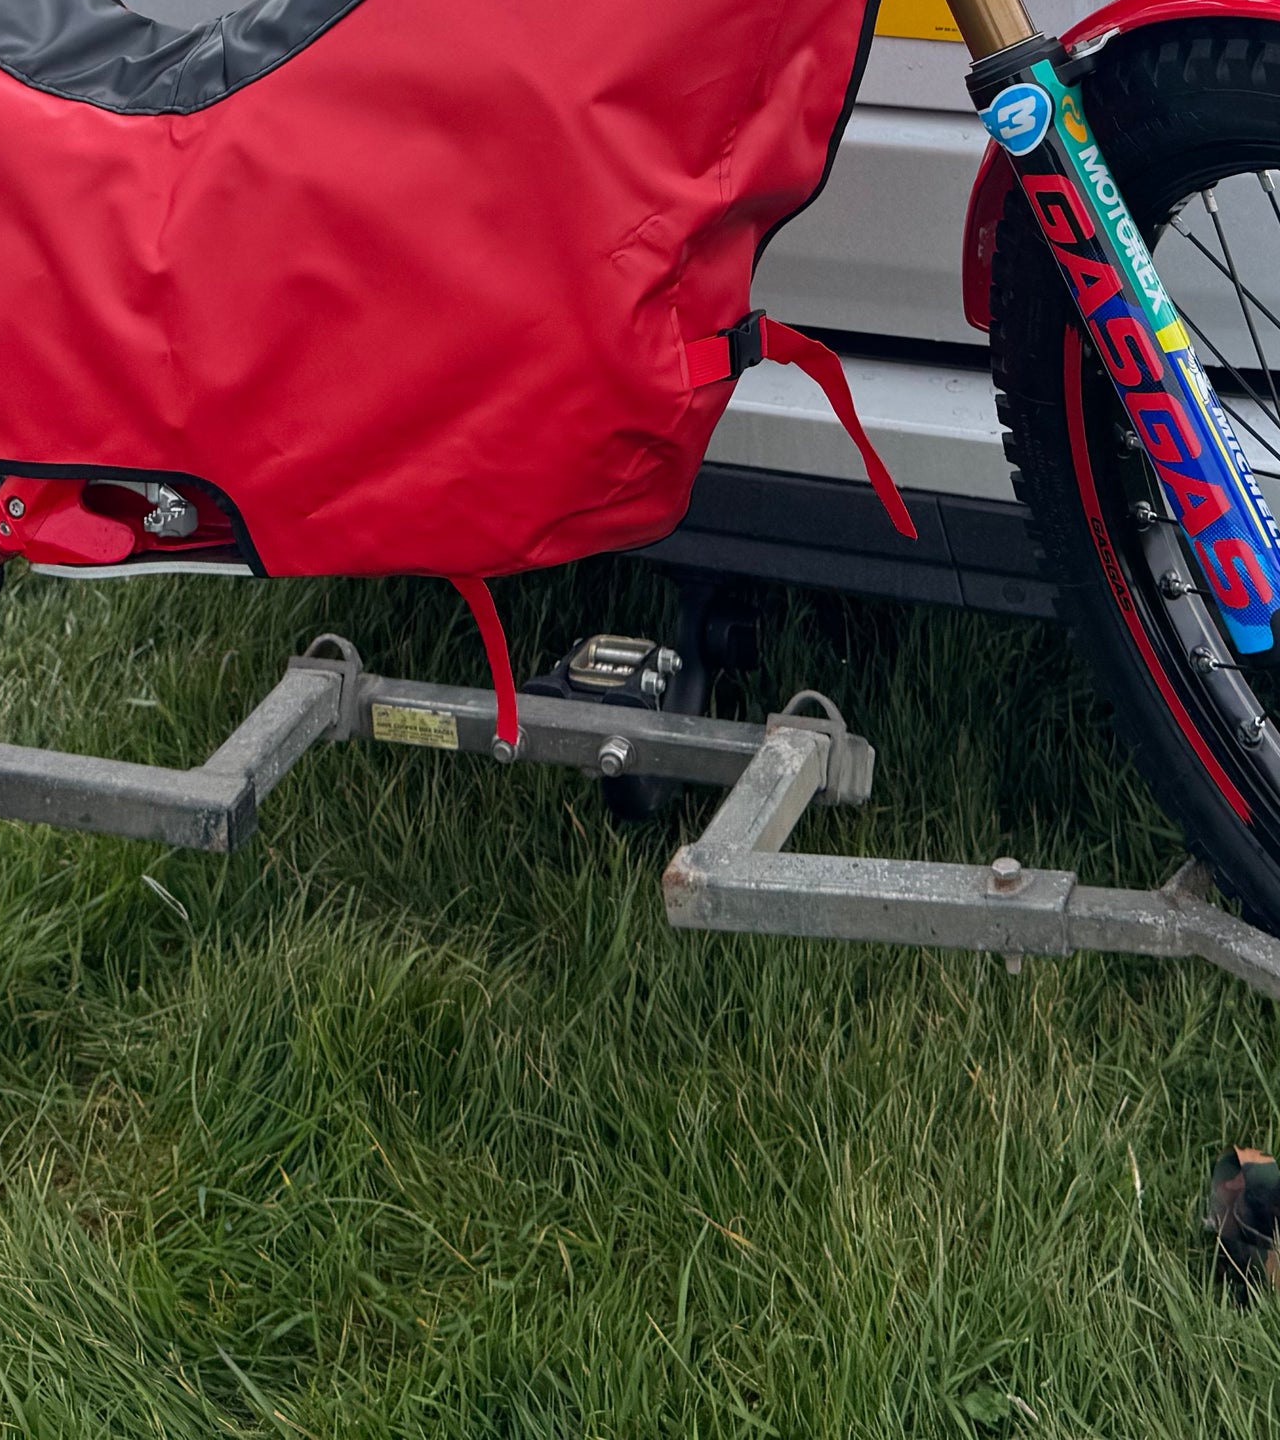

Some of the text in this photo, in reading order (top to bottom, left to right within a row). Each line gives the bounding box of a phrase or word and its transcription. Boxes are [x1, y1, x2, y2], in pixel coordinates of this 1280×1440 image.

[1078, 144, 1169, 313] MOTOREX
[1021, 173, 1274, 610] GASGAS
[1090, 516, 1132, 613] GASGAS
